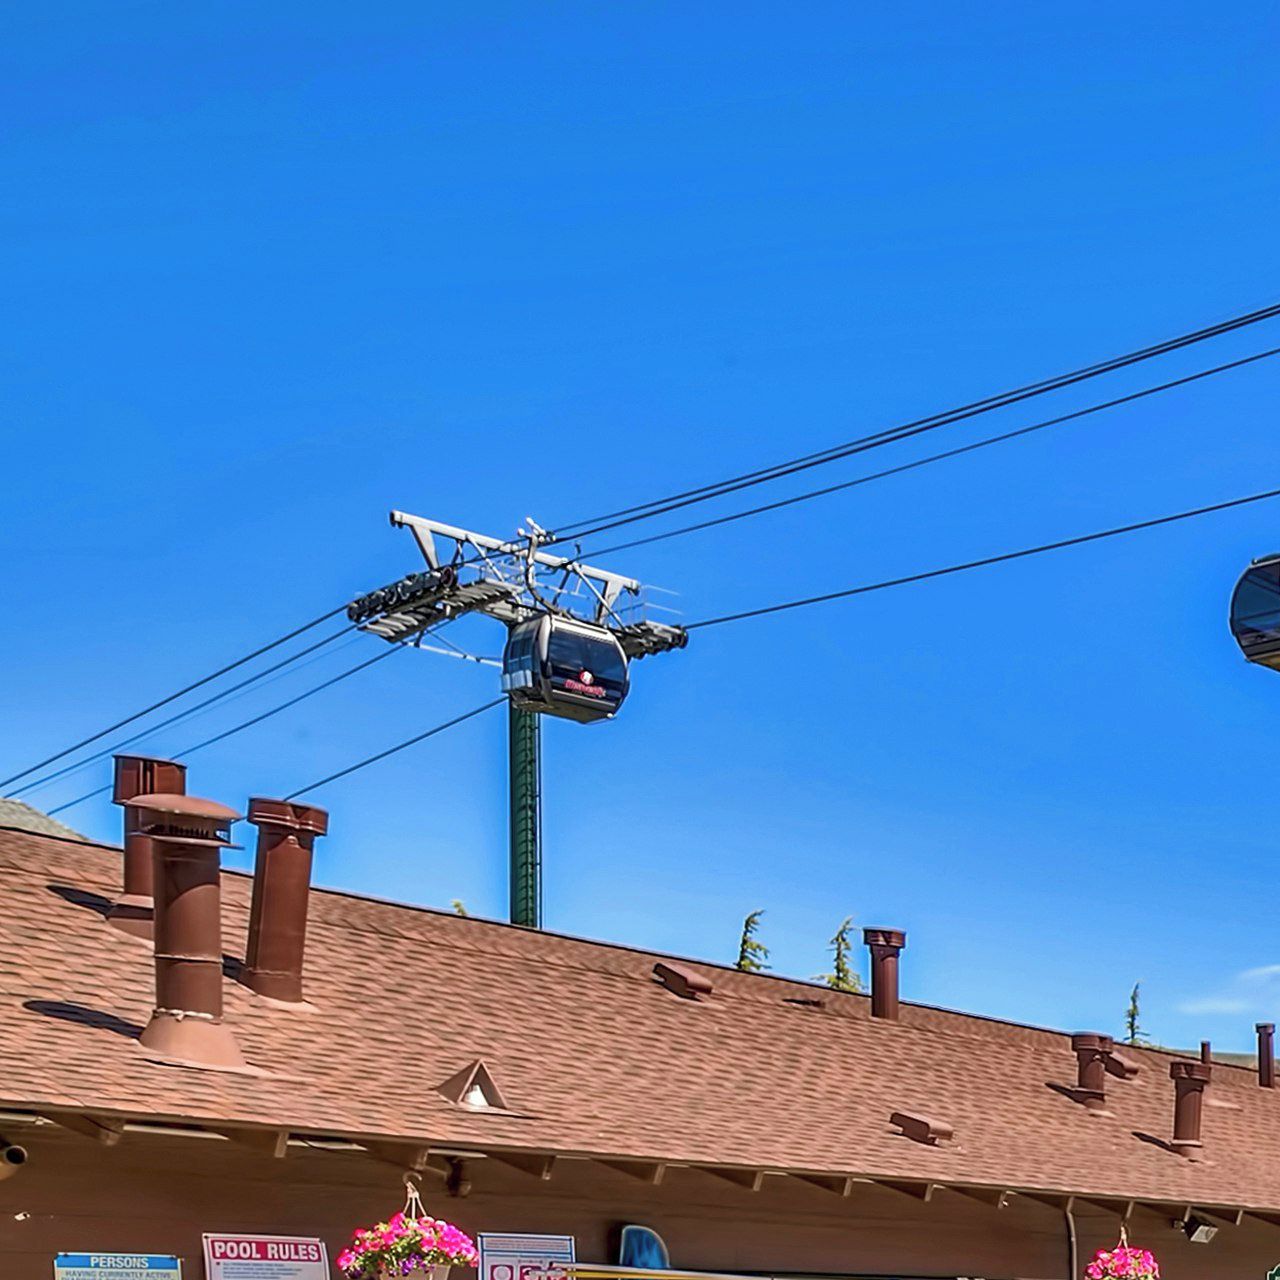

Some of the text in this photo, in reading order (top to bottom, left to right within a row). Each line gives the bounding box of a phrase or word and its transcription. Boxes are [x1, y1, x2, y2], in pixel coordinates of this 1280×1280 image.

[214, 1241, 319, 1260] POOL RULES
[90, 1256, 149, 1268] PERSONS
[99, 1270, 142, 1278] CURRENTLY
[146, 1271, 171, 1279] ACTIVE
